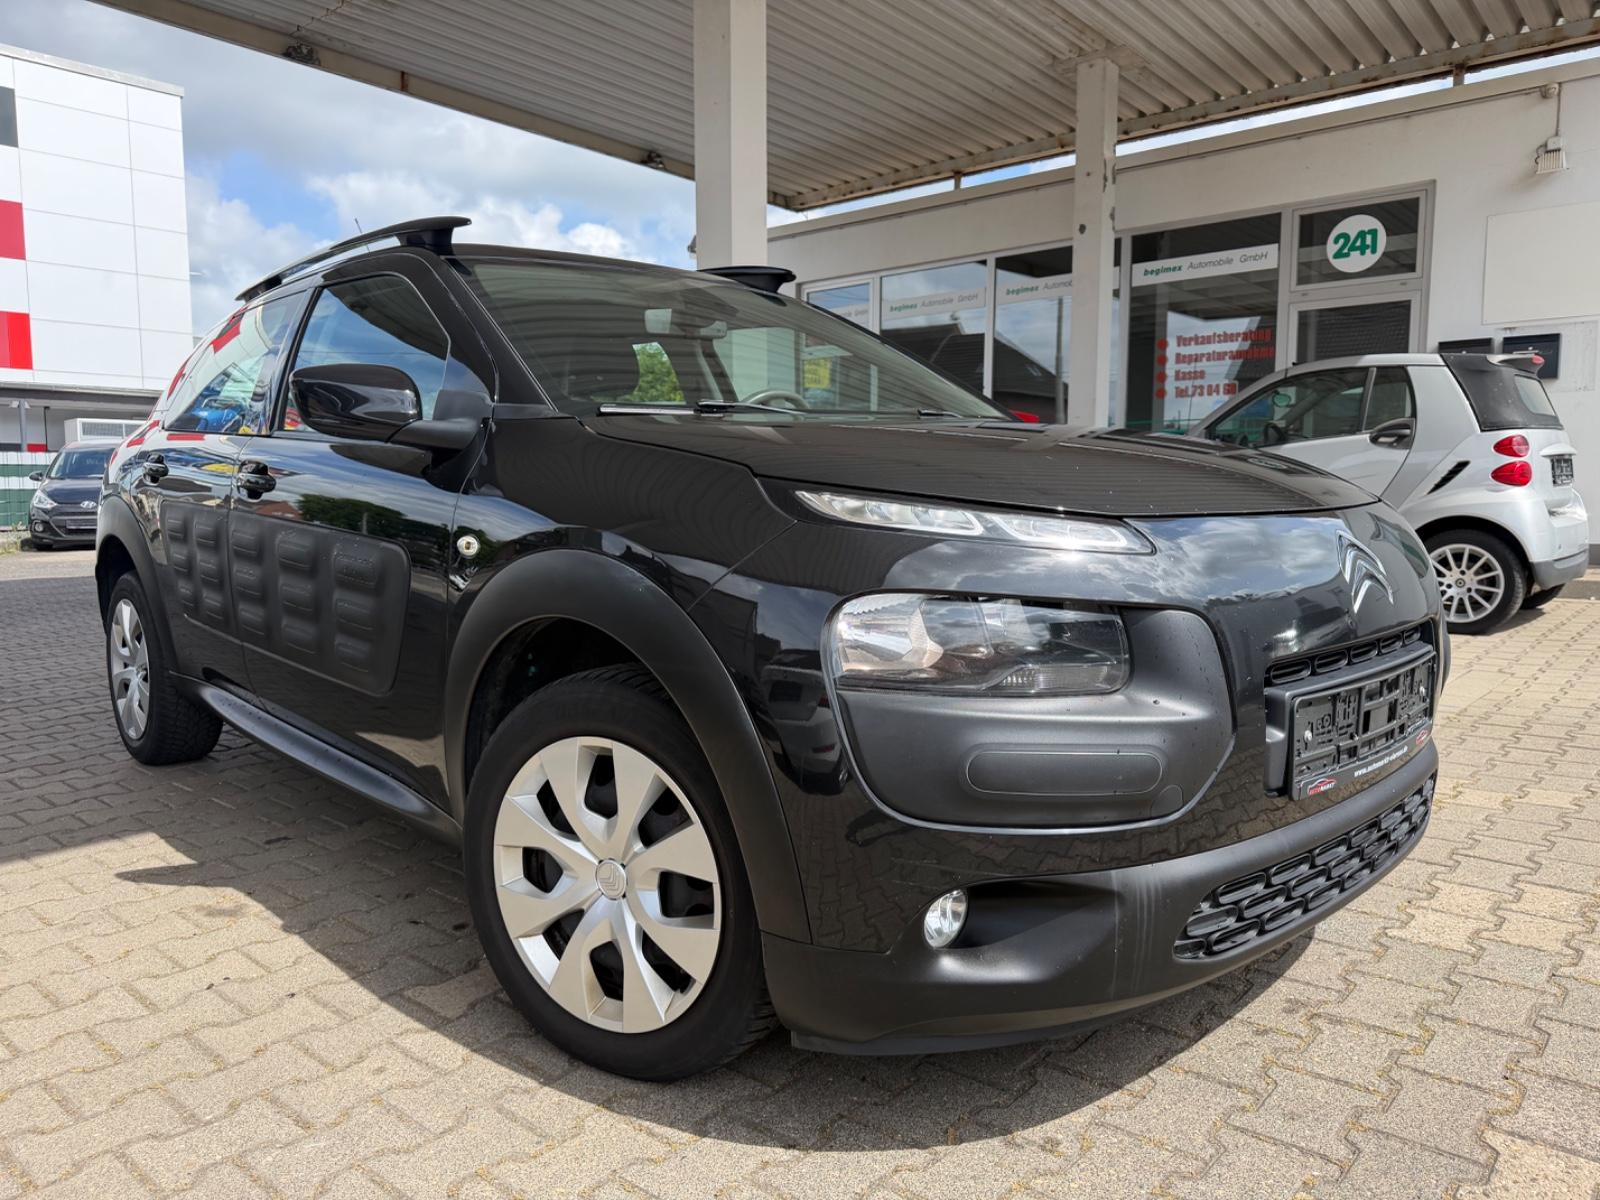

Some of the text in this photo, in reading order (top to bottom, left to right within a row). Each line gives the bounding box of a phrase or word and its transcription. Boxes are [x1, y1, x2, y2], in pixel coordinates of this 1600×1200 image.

[1332, 228, 1378, 259] 241
[1143, 251, 1269, 277] begimex Automobile GmbH
[1174, 369, 1206, 381] Kasse
[1207, 383, 1220, 396] 04
